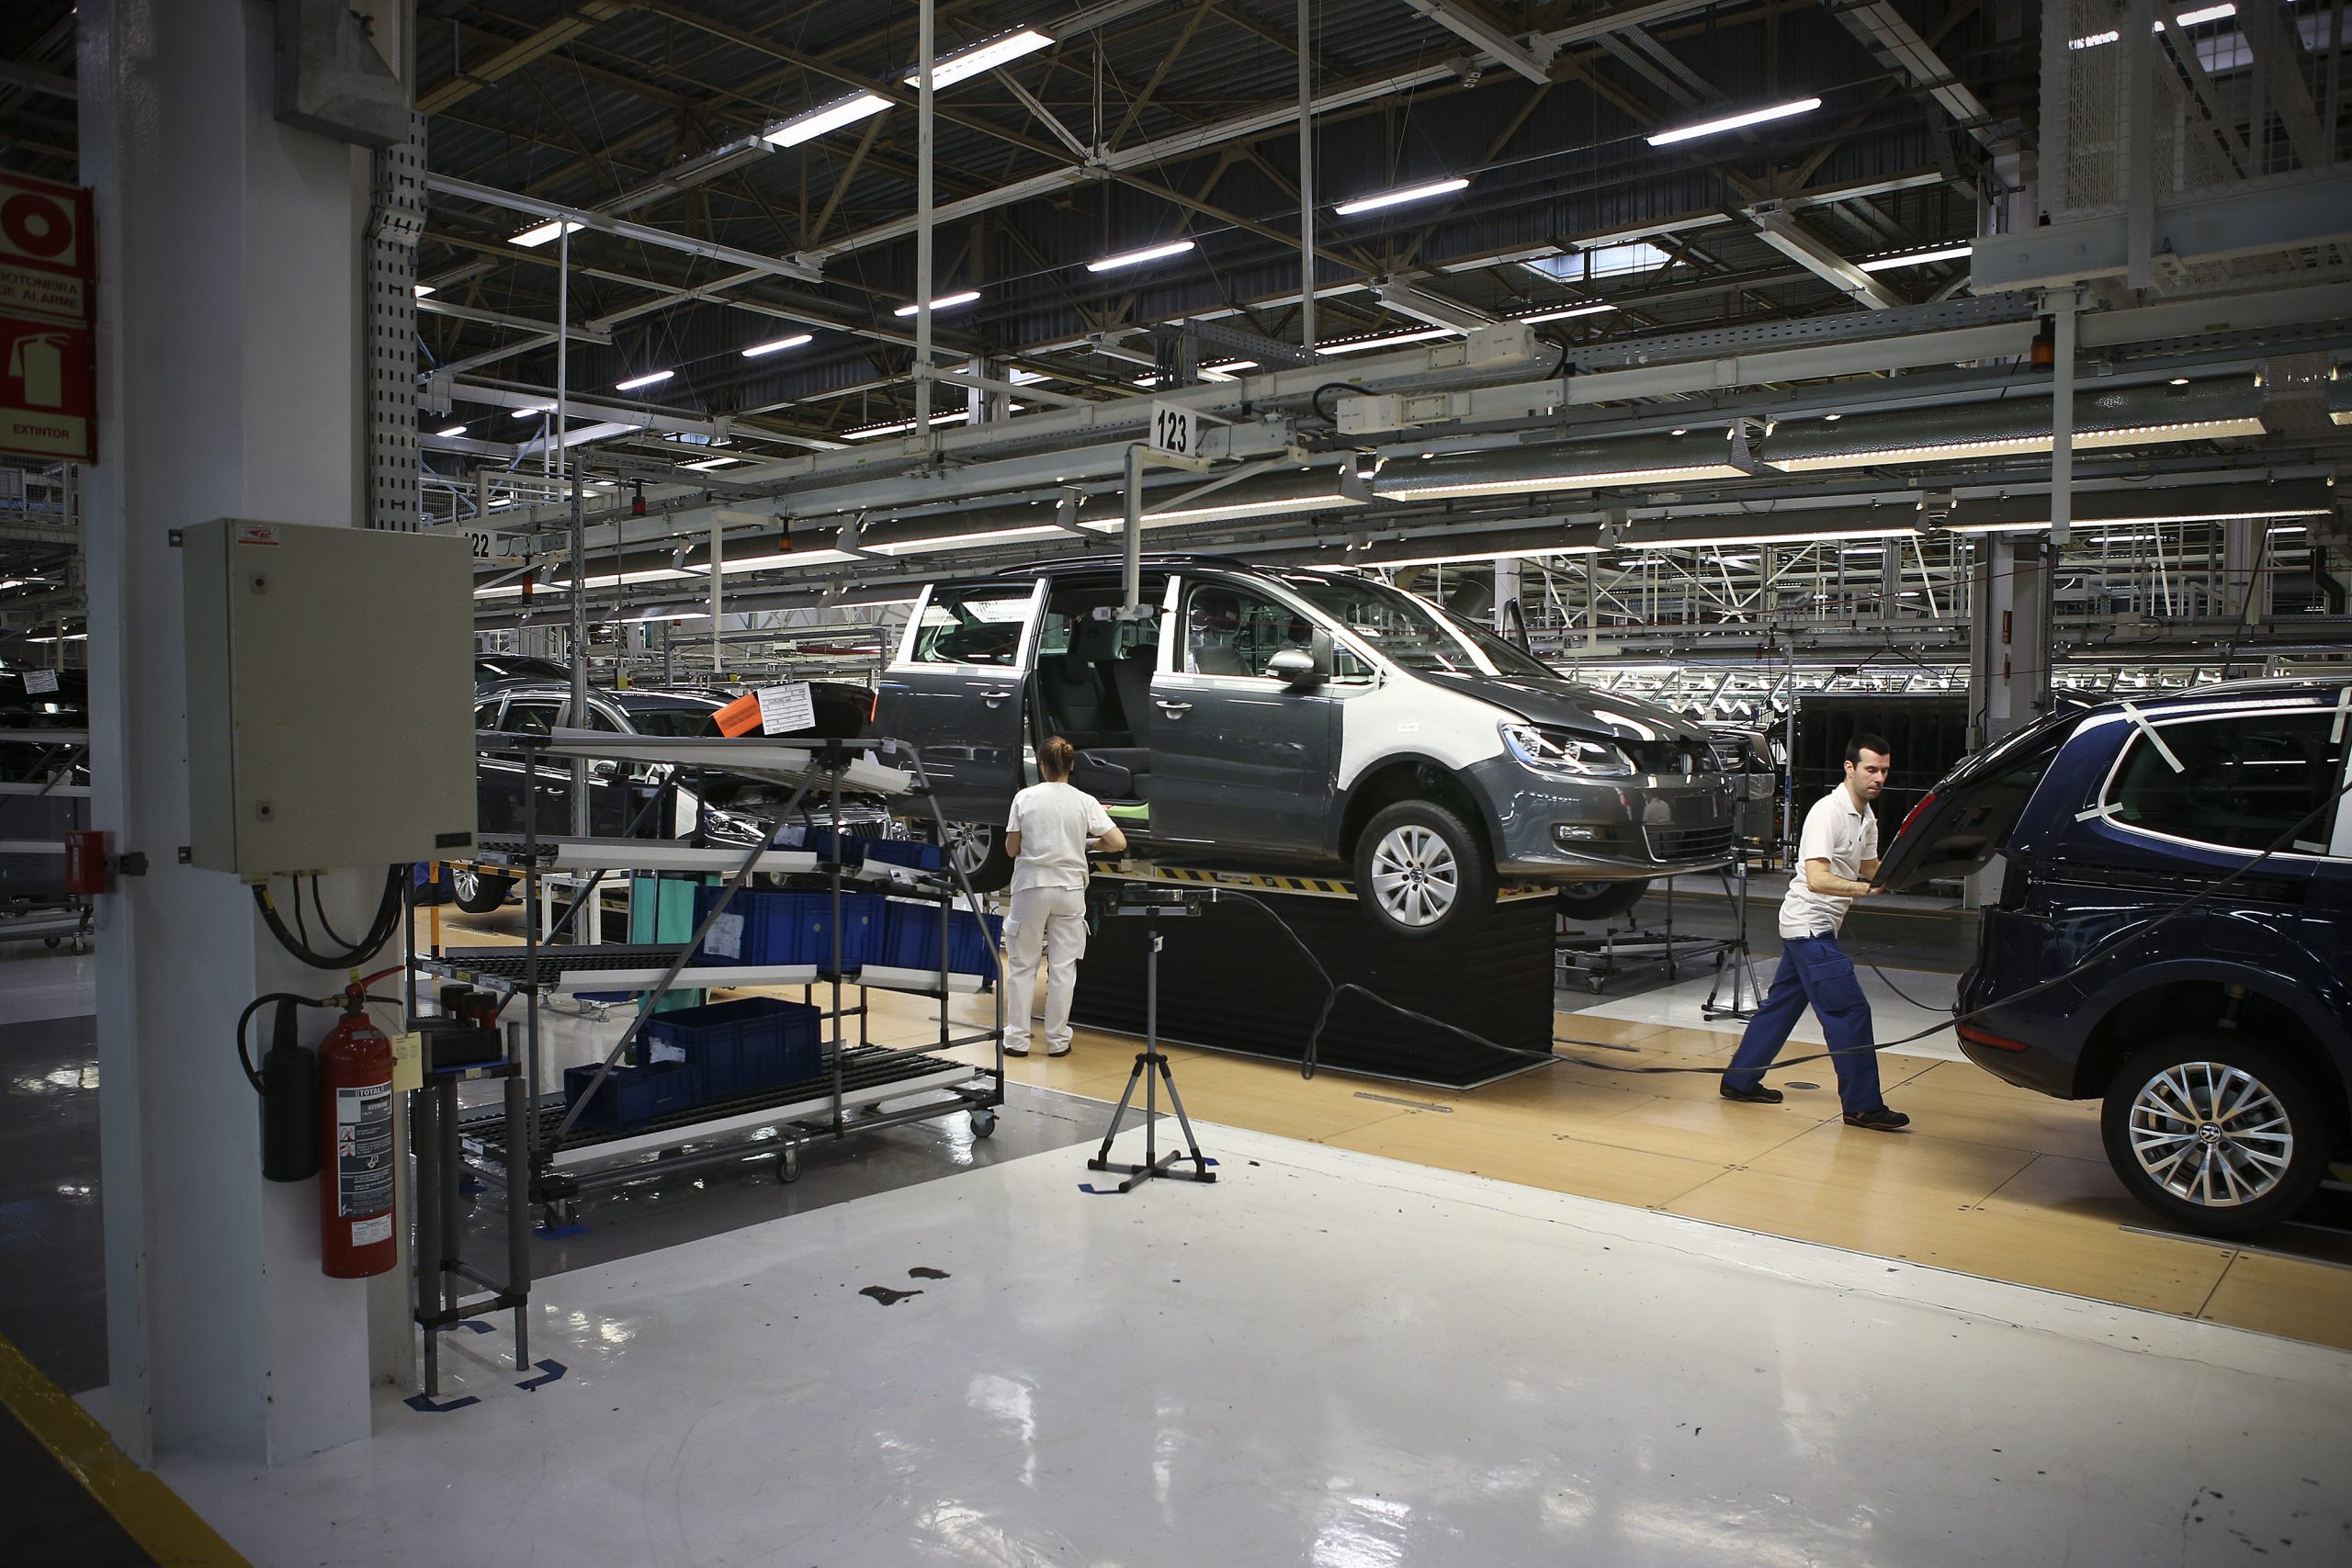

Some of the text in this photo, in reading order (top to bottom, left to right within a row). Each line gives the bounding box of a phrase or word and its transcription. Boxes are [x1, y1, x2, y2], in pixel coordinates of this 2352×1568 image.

[0, 271, 77, 294] BOTONEIRA
[23, 288, 78, 310] ALARME
[14, 423, 70, 439] EXTINTOR
[1158, 410, 1186, 453] 123
[464, 532, 489, 558] 22
[360, 1087, 380, 1096] TOTAL
